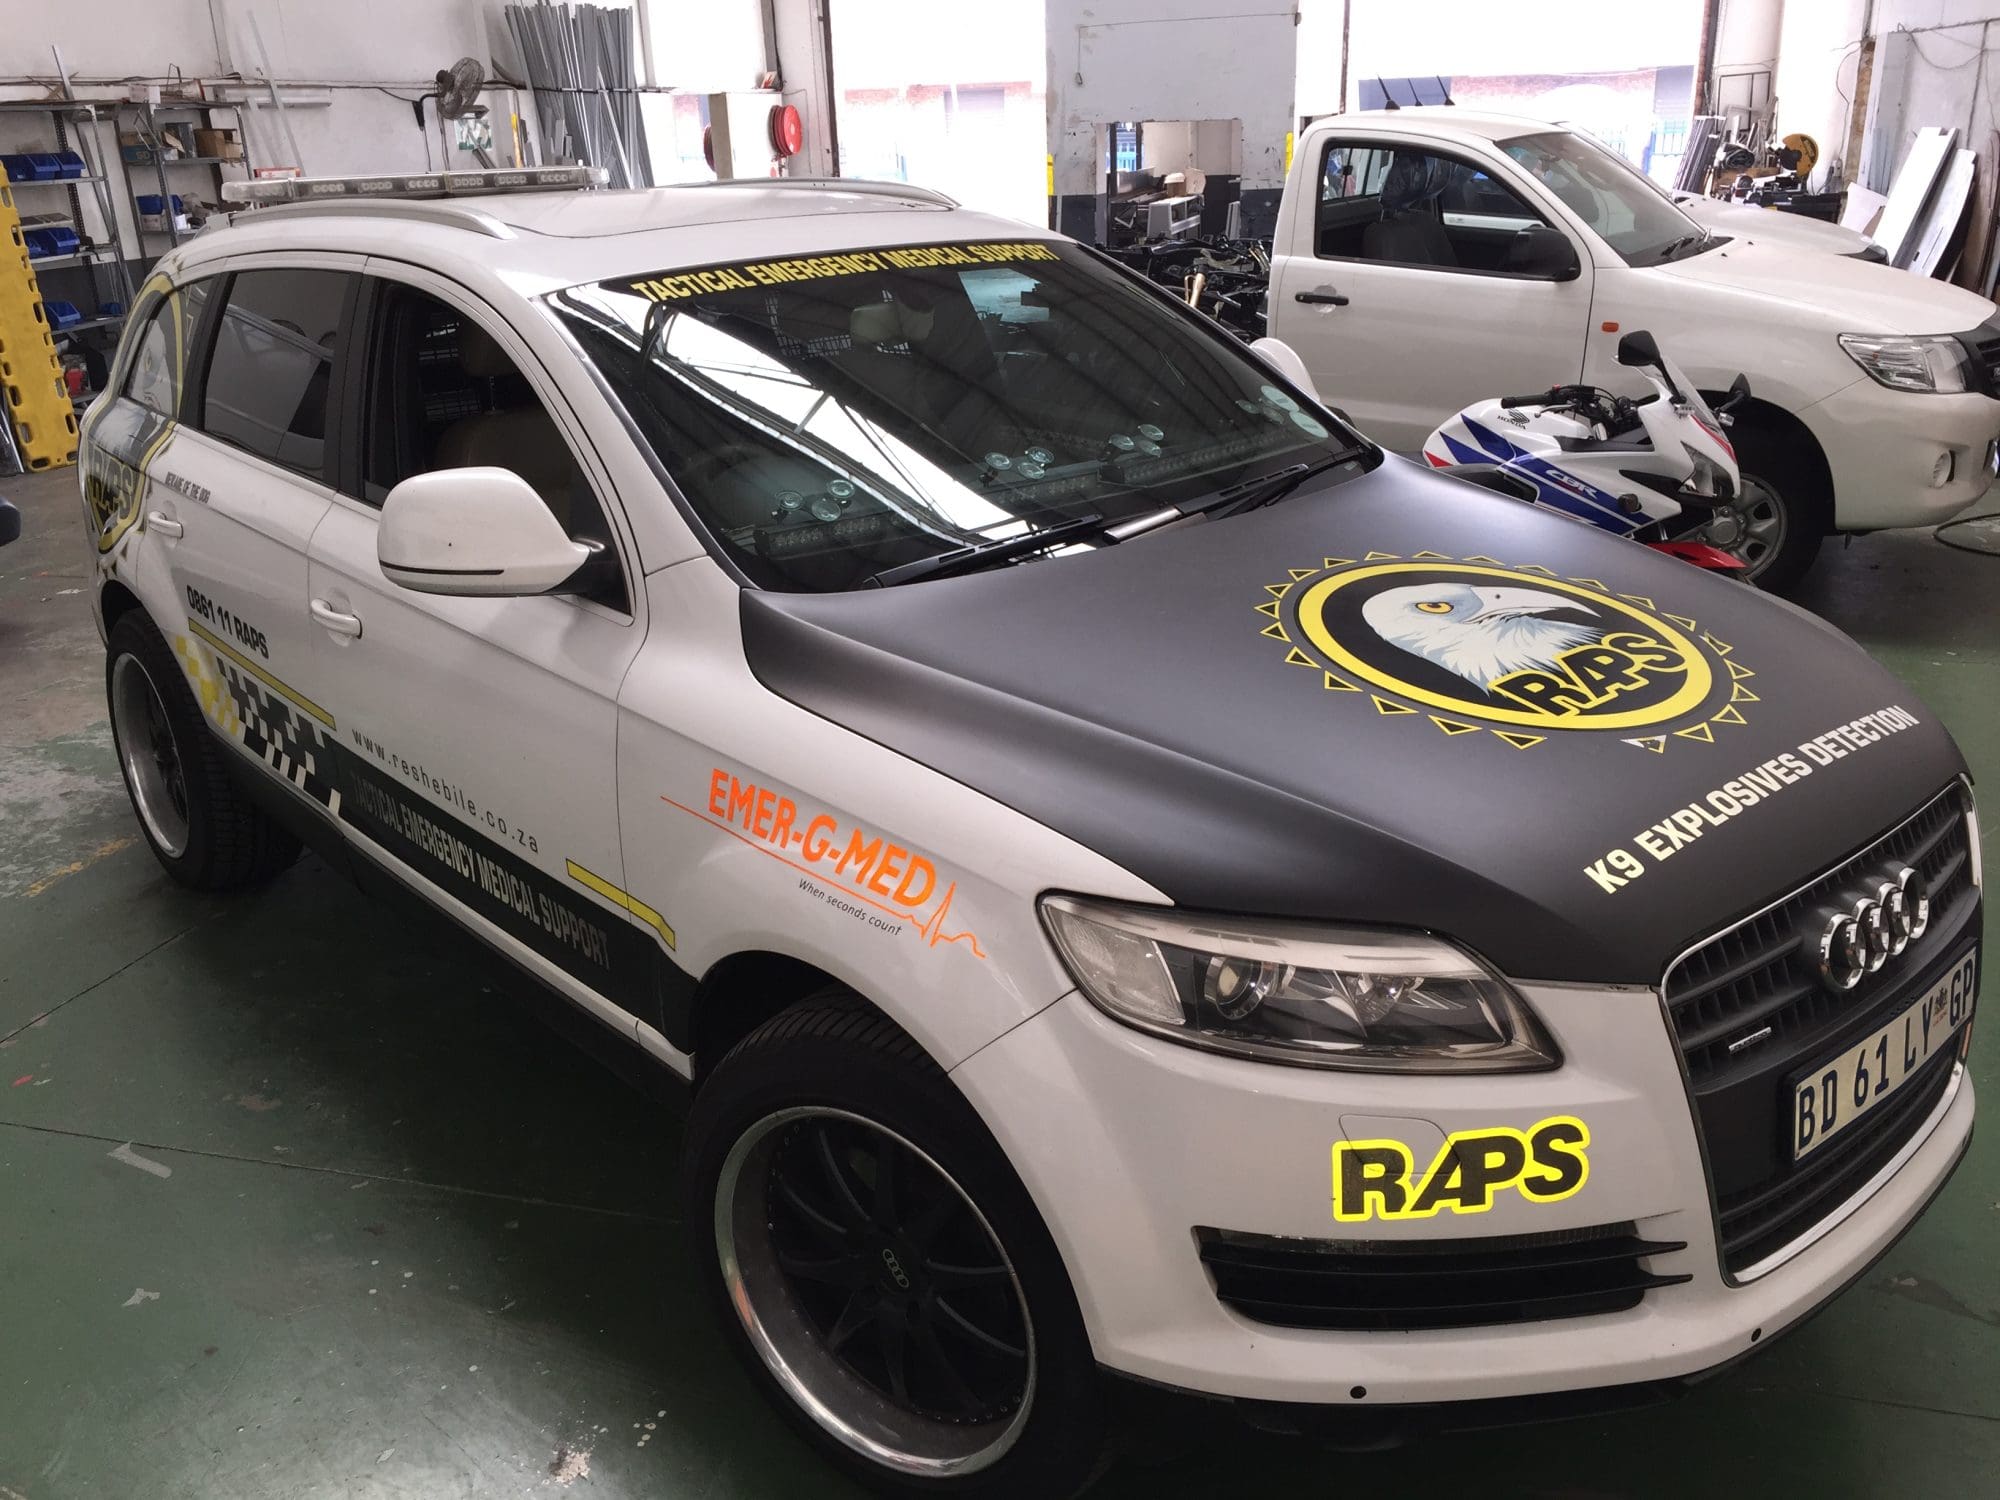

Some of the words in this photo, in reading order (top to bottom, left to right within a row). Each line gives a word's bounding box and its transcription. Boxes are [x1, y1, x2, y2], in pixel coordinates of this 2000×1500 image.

[631, 268, 757, 303] TACTICAL
[744, 252, 889, 285] EMERGENCY
[880, 247, 981, 269] MEDICAL
[967, 244, 1061, 263] SUPPORT
[187, 584, 216, 625] 0861
[217, 606, 232, 636] 11
[234, 615, 269, 660] RAPS
[1488, 633, 1687, 717] RAPS
[352, 728, 539, 854] www.reshebile.co.za
[708, 768, 937, 907] EMER-G-MED
[1583, 849, 1645, 894] K9
[1633, 752, 1813, 862] EXPLOSIVES
[1797, 705, 1920, 767] DETECTION
[400, 803, 476, 882] EMERGENCY
[476, 852, 541, 926] MEDICAL
[539, 893, 609, 969] SUPPORT
[799, 878, 825, 899] When
[826, 895, 867, 921] seconds
[868, 916, 902, 936] count
[1799, 1069, 1838, 1149] BD
[1854, 1034, 1889, 1108] 61
[1904, 996, 1933, 1074] LY
[1950, 958, 1973, 1027] GP
[1333, 1116, 1590, 1221] RAPS
